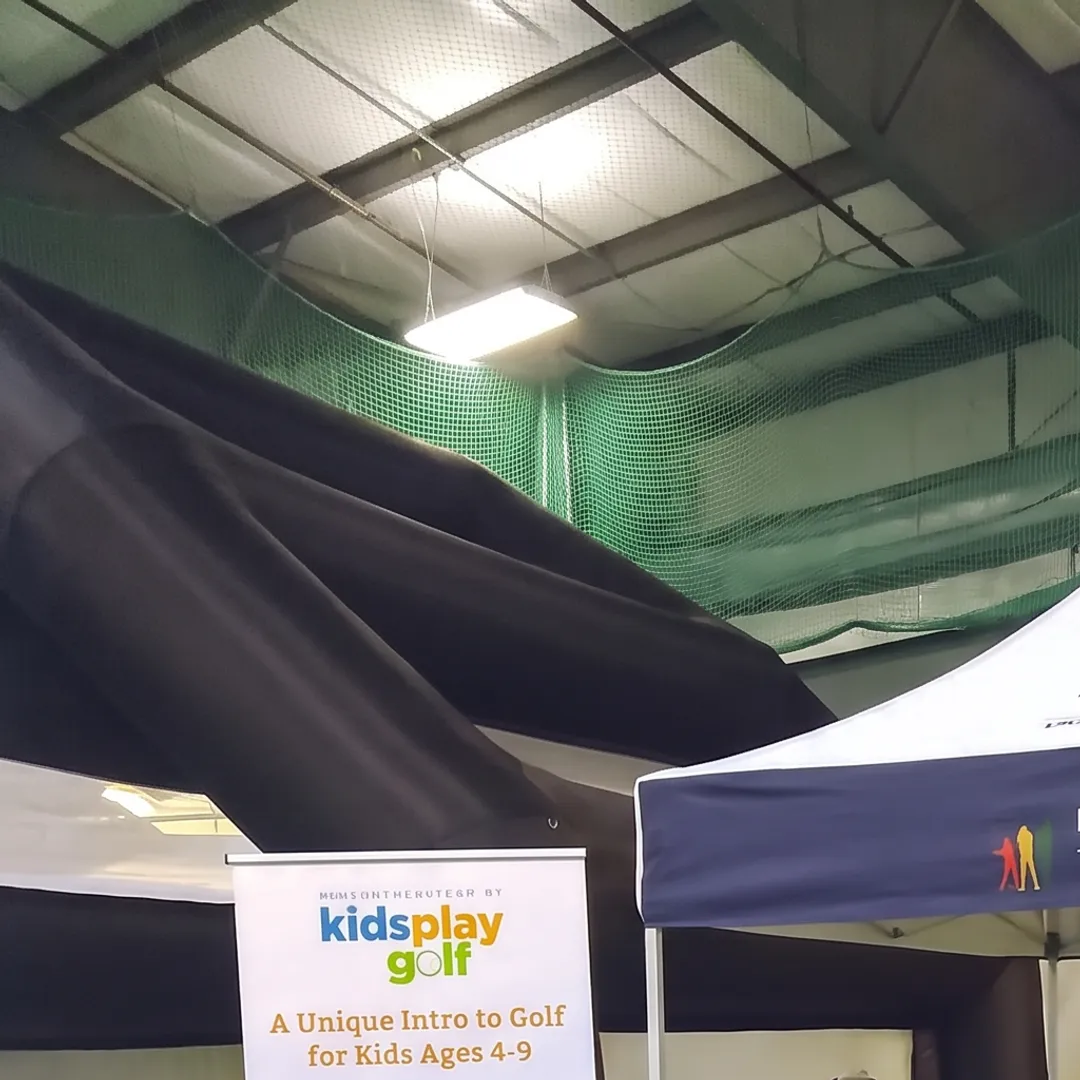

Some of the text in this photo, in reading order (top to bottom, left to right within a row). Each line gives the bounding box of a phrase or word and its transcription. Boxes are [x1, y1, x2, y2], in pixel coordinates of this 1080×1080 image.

[319, 904, 505, 948] kidsplay
[386, 941, 473, 986] golf
[270, 1003, 567, 1038] A Unique Intro to Golf
[308, 1040, 533, 1070] for Kids Ages 4-9
